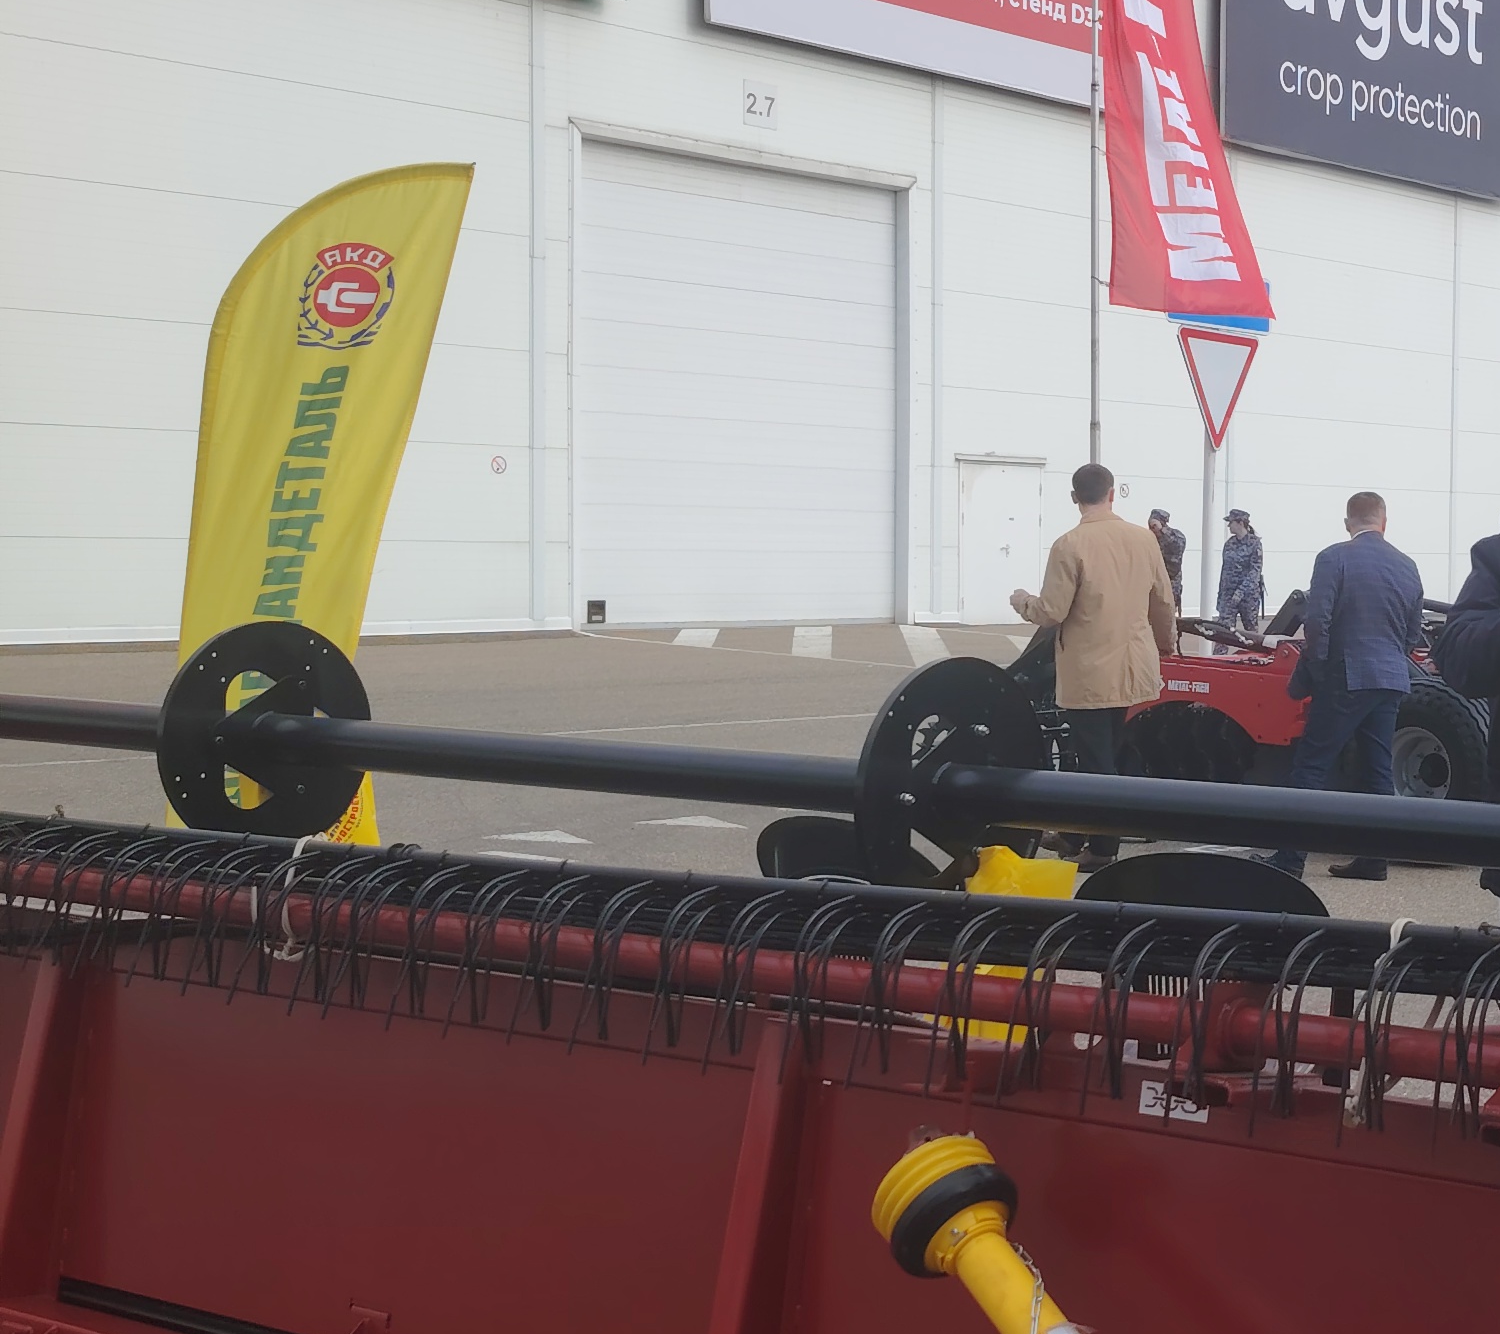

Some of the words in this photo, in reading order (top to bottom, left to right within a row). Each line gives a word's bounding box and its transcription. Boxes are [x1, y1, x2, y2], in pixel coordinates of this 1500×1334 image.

[746, 94, 775, 118] 2.7
[1279, 59, 1344, 115] crop
[1352, 78, 1482, 141] protection
[324, 246, 387, 269] АКД
[252, 364, 349, 624] АНДЕТАЛЬ
